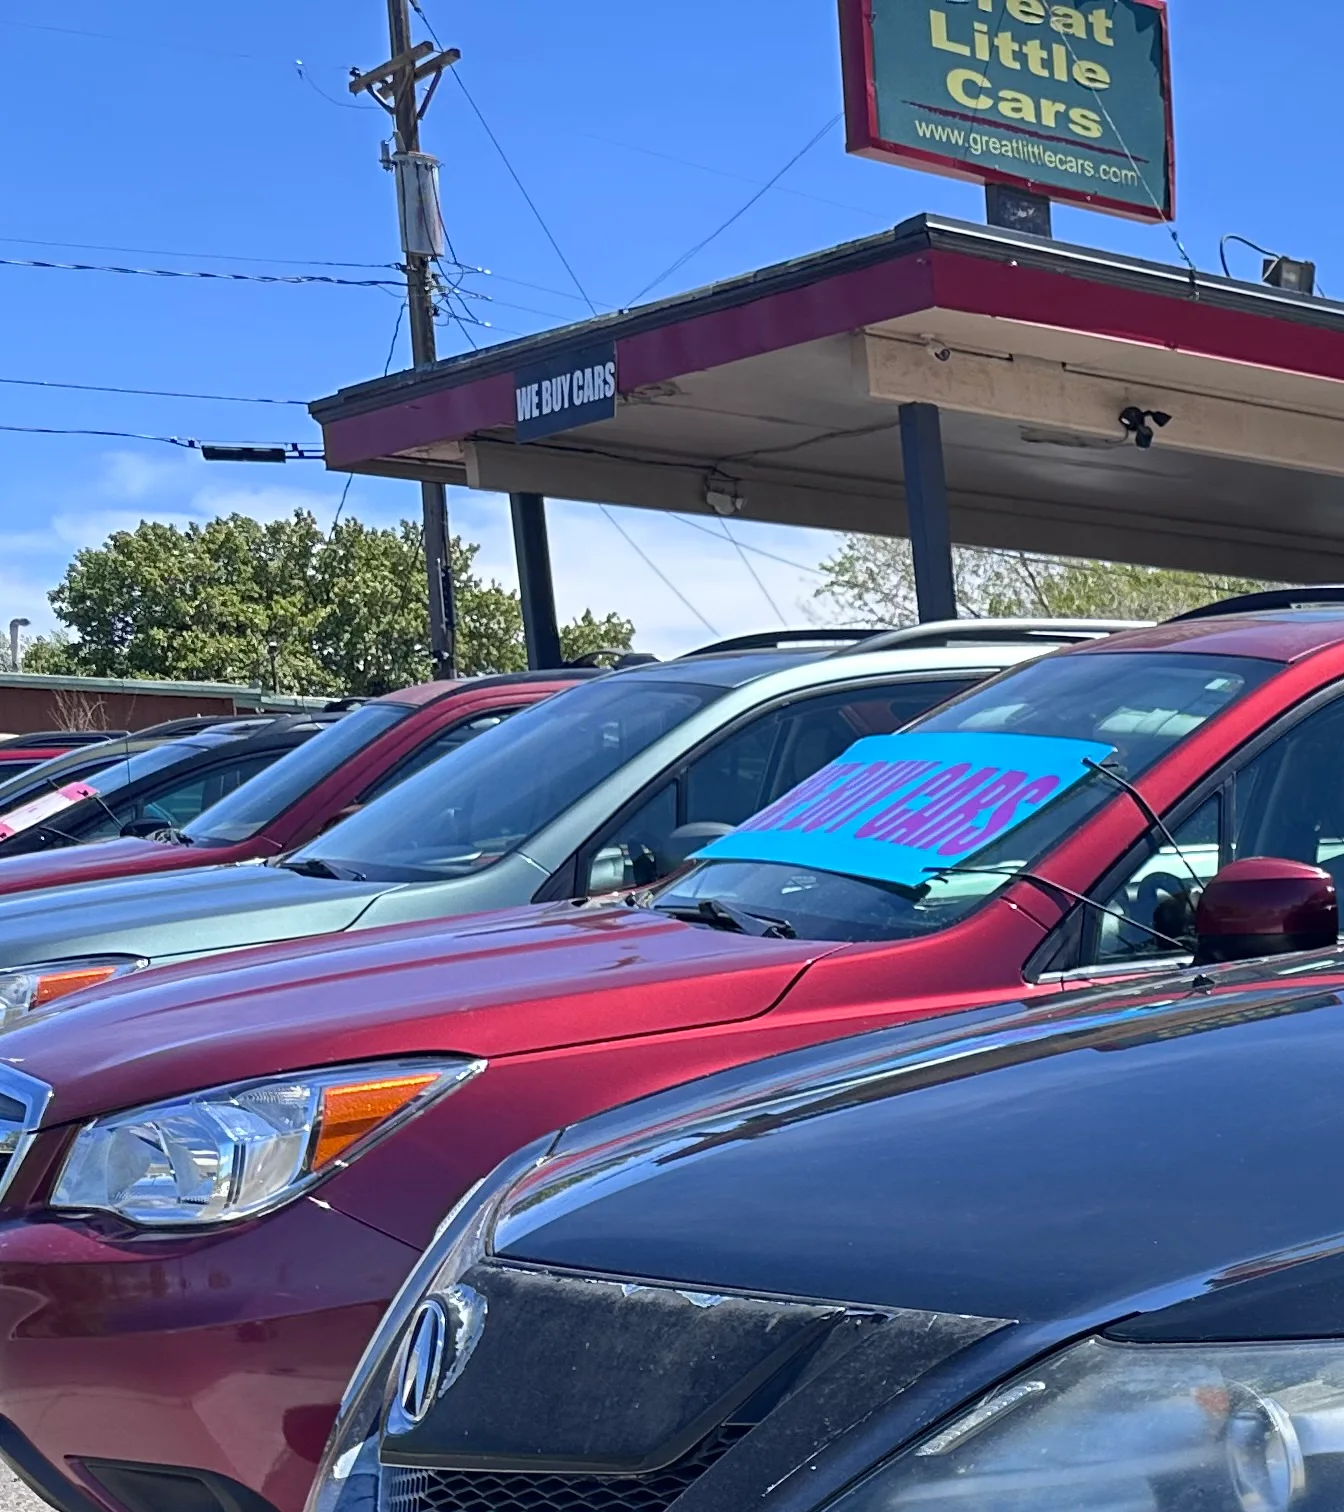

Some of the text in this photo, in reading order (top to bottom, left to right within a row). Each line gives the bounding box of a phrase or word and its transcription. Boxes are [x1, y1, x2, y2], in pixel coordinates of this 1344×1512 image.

[929, 9, 1112, 90] Little
[946, 0, 1115, 46] eat
[946, 68, 1103, 138] Cars
[915, 119, 1139, 187] www.greatlittlecars.com
[516, 361, 616, 422] WE BUY CARS
[777, 760, 942, 833] BUY
[853, 763, 1061, 856] CARS
